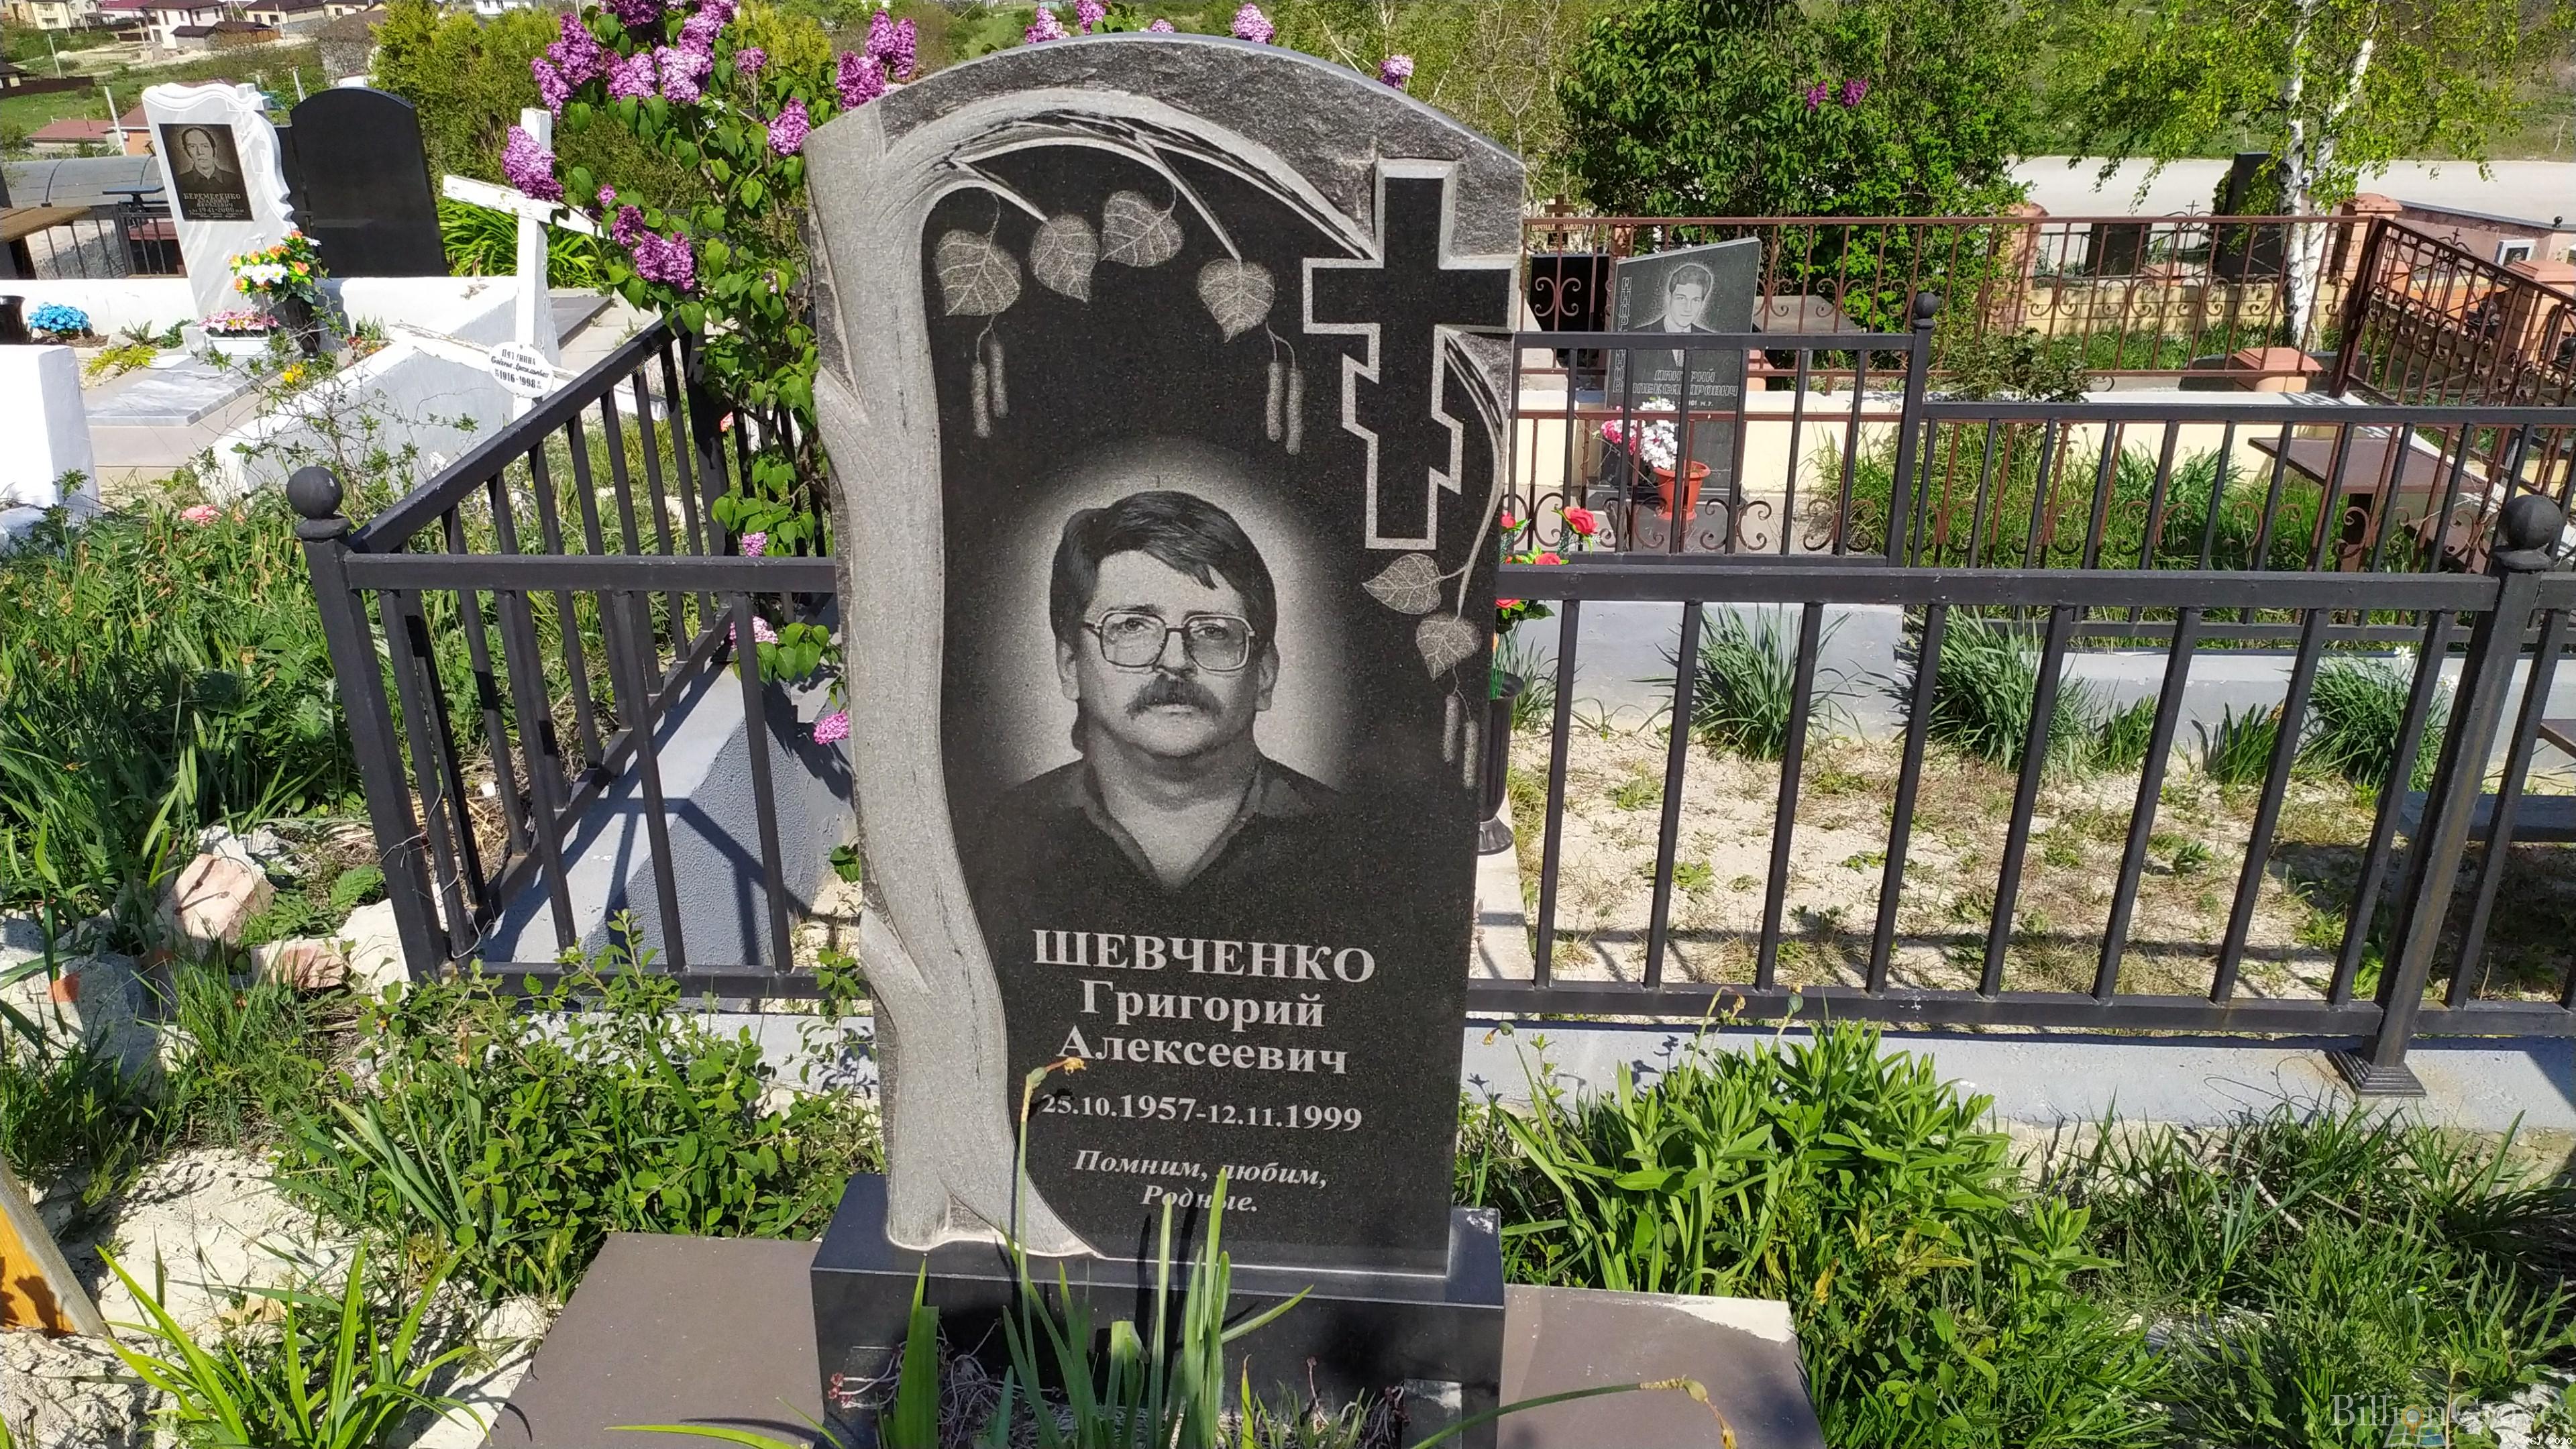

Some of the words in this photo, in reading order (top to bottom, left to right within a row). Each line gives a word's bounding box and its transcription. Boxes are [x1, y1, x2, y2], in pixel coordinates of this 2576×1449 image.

[1654, 368, 1715, 382] ДМИРИЙ
[1032, 928, 1375, 983] ШЕВЧЕНКО
[1079, 979, 1325, 1032] Григорий
[1056, 1025, 1348, 1074] Алексеевич
[1041, 1093, 1362, 1132] 25.10.1957-12.11.1999
[1073, 1150, 1208, 1182] Помним,
